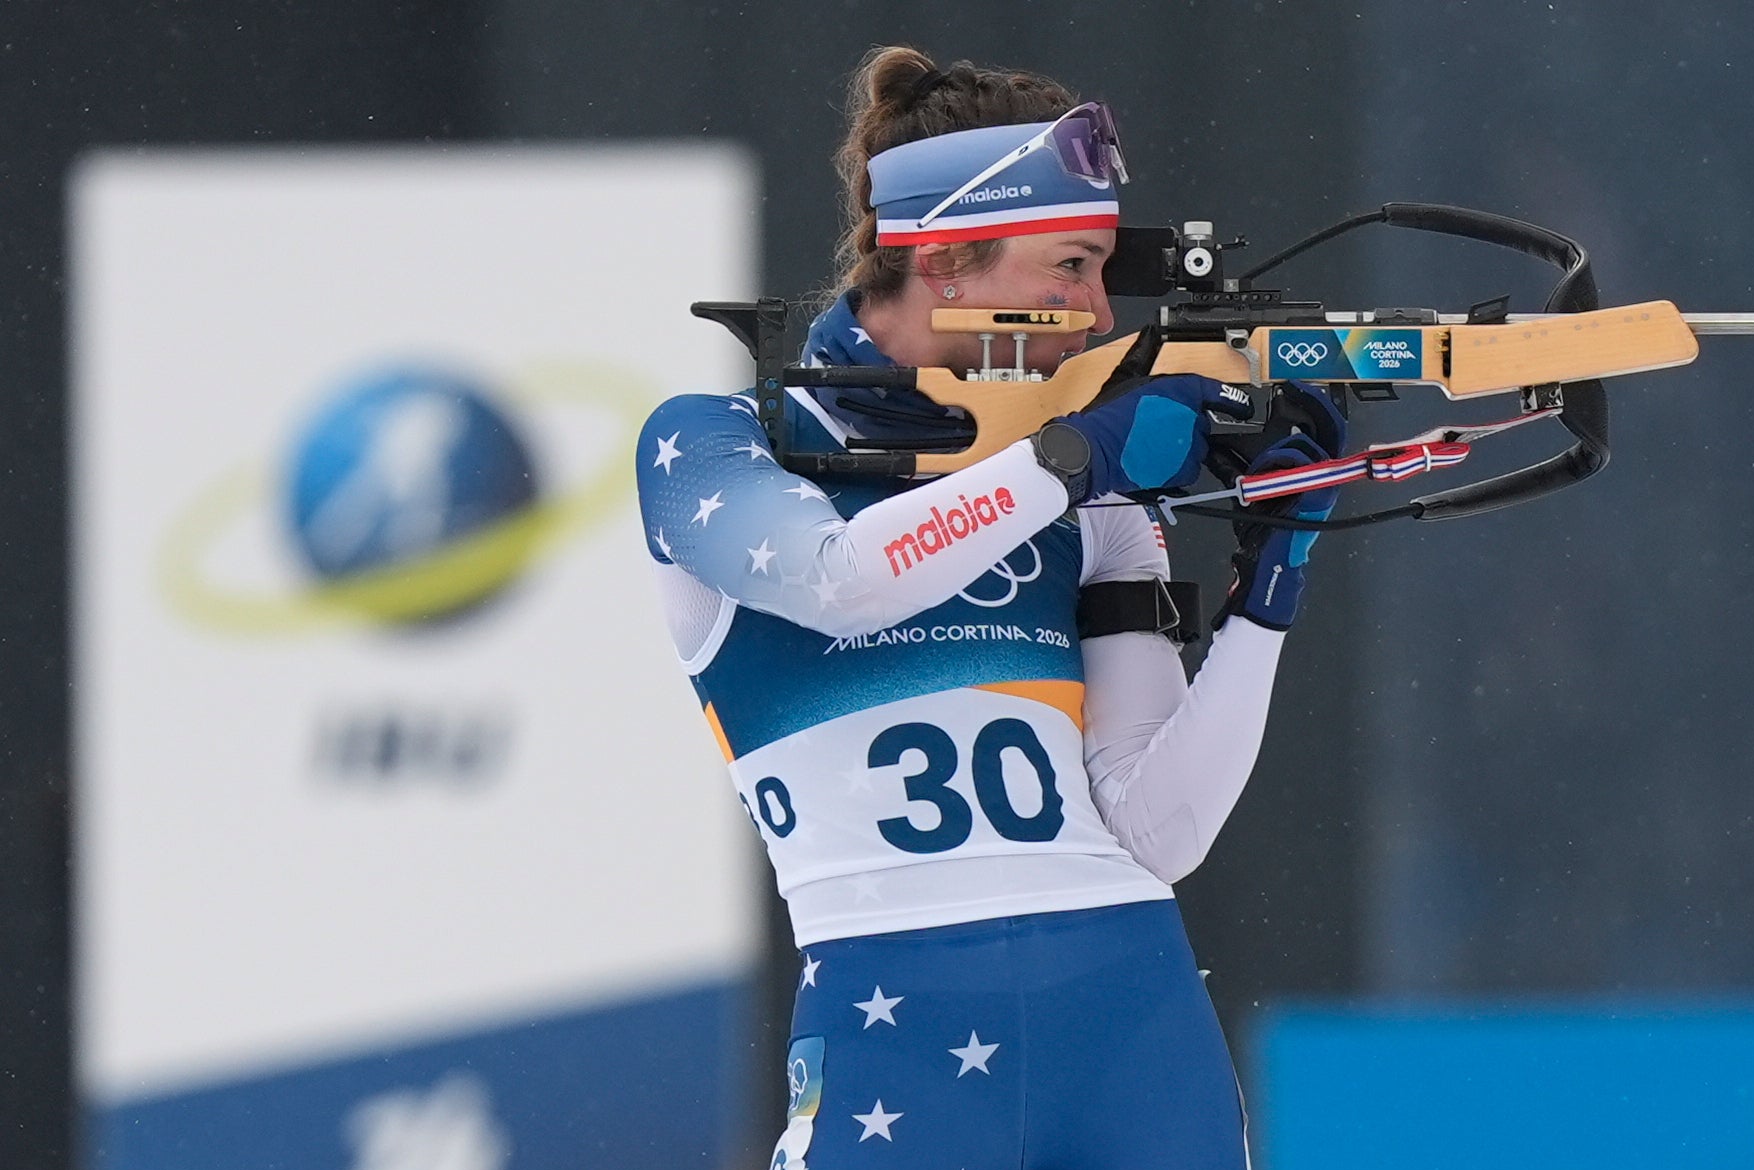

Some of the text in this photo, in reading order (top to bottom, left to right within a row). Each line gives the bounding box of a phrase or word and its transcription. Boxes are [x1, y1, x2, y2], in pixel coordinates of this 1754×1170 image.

[1363, 341, 1407, 350] MILANO
[1370, 350, 1416, 359] CORTINA
[1378, 359, 1400, 368] 2026
[884, 494, 998, 577] maloja
[823, 624, 1071, 655] MILANO CORTINA 2026
[867, 717, 1064, 854] 30
[739, 776, 797, 838] 0
